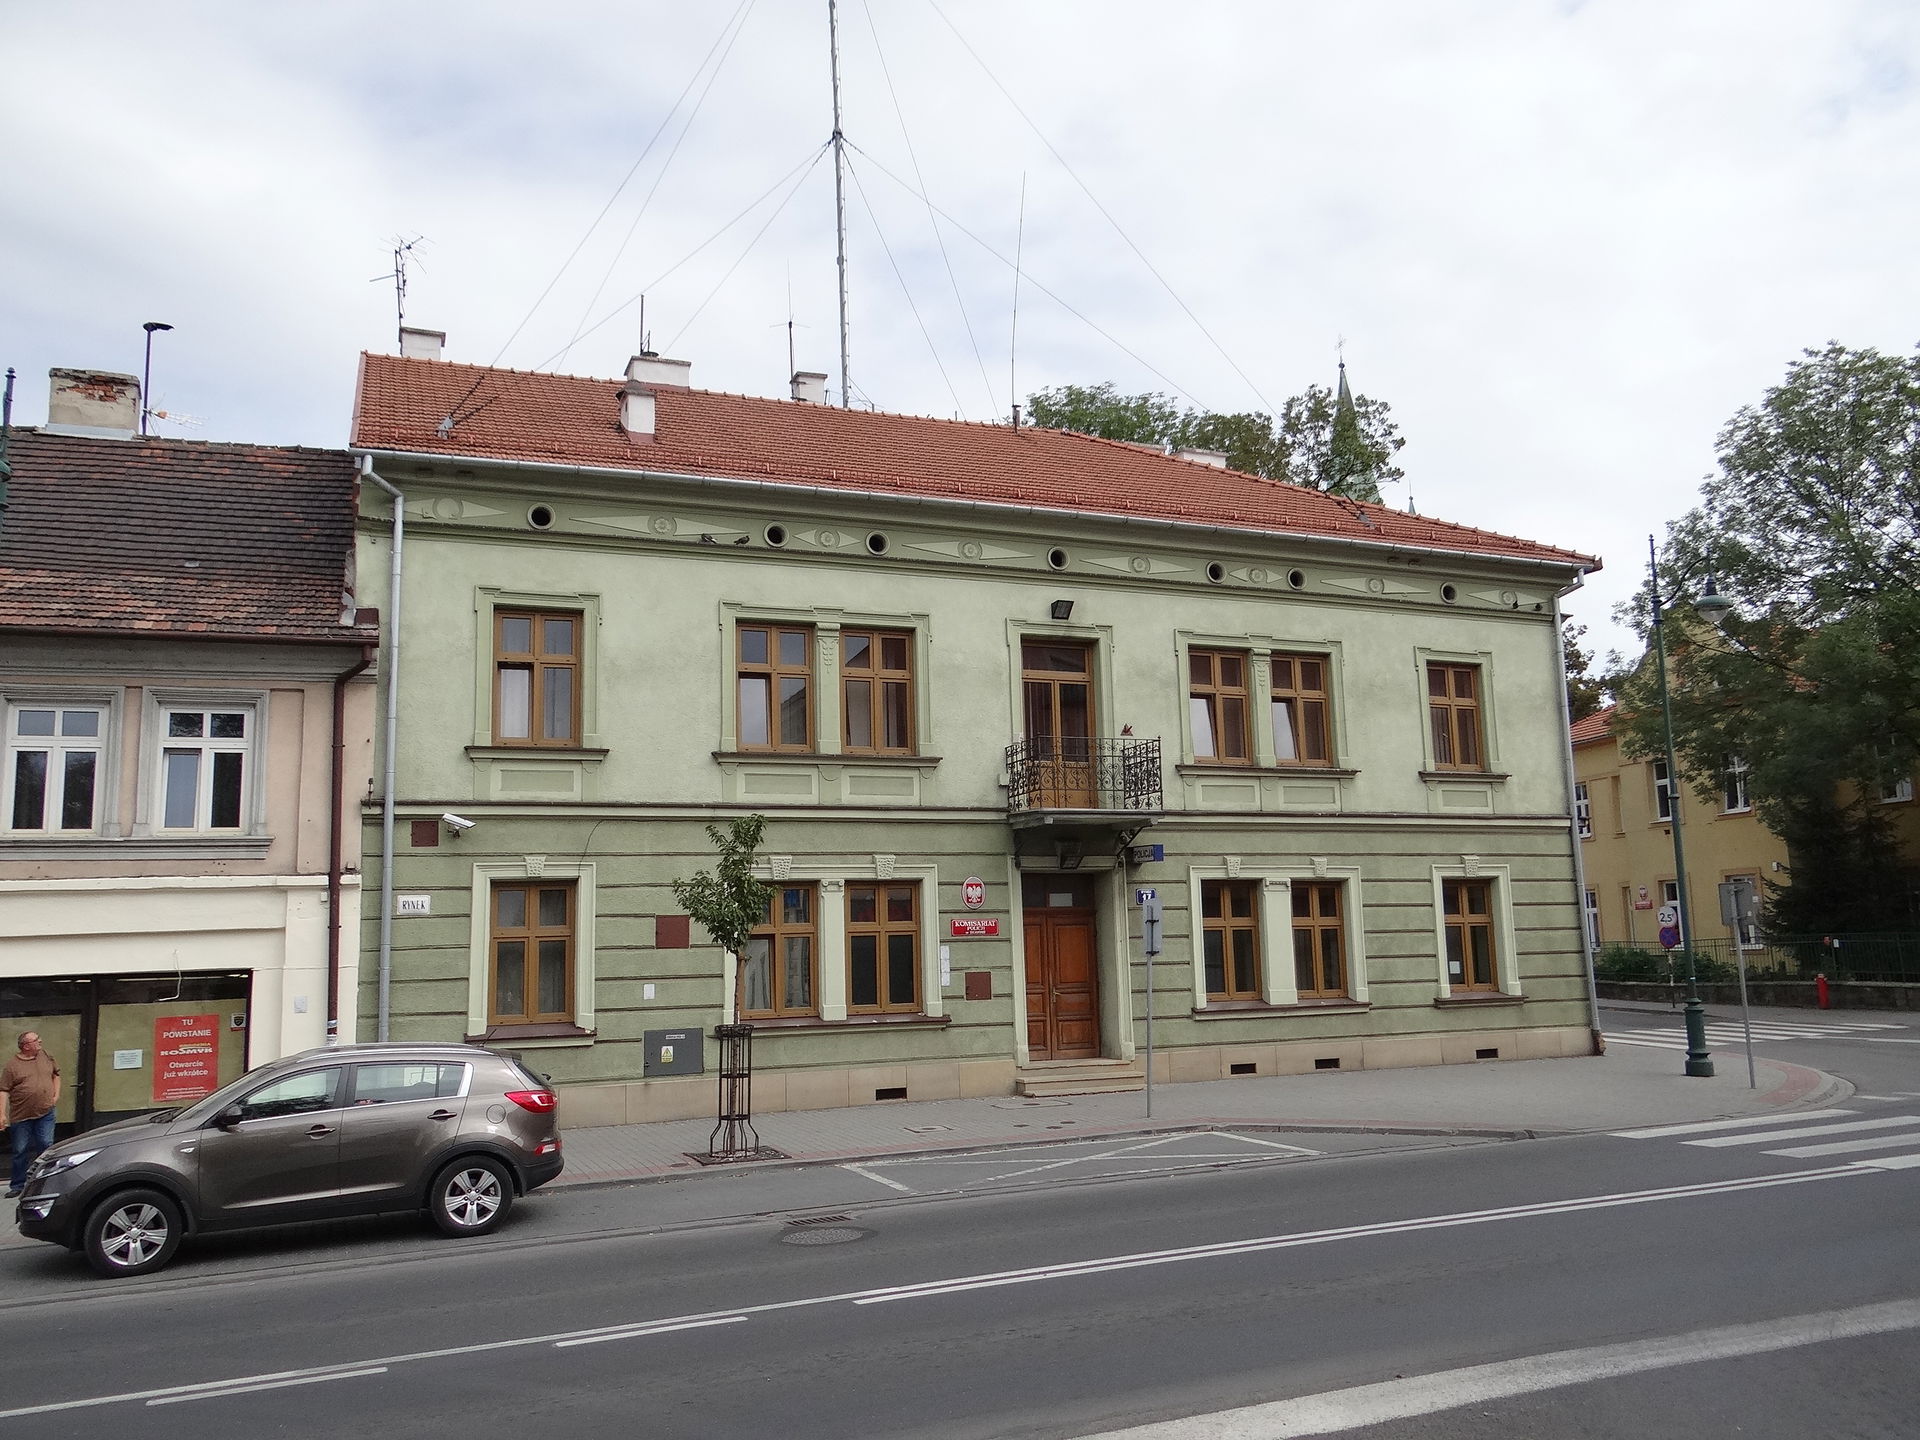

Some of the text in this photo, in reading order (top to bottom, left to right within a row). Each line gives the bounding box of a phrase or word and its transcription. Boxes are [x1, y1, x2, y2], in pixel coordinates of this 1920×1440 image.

[1142, 893, 1152, 901] 17
[402, 900, 426, 910] RYNEK
[163, 1029, 212, 1039] POWSTANIE
[169, 1060, 204, 1069] Otwarcie
[163, 1069, 208, 1080] już wkrótce
